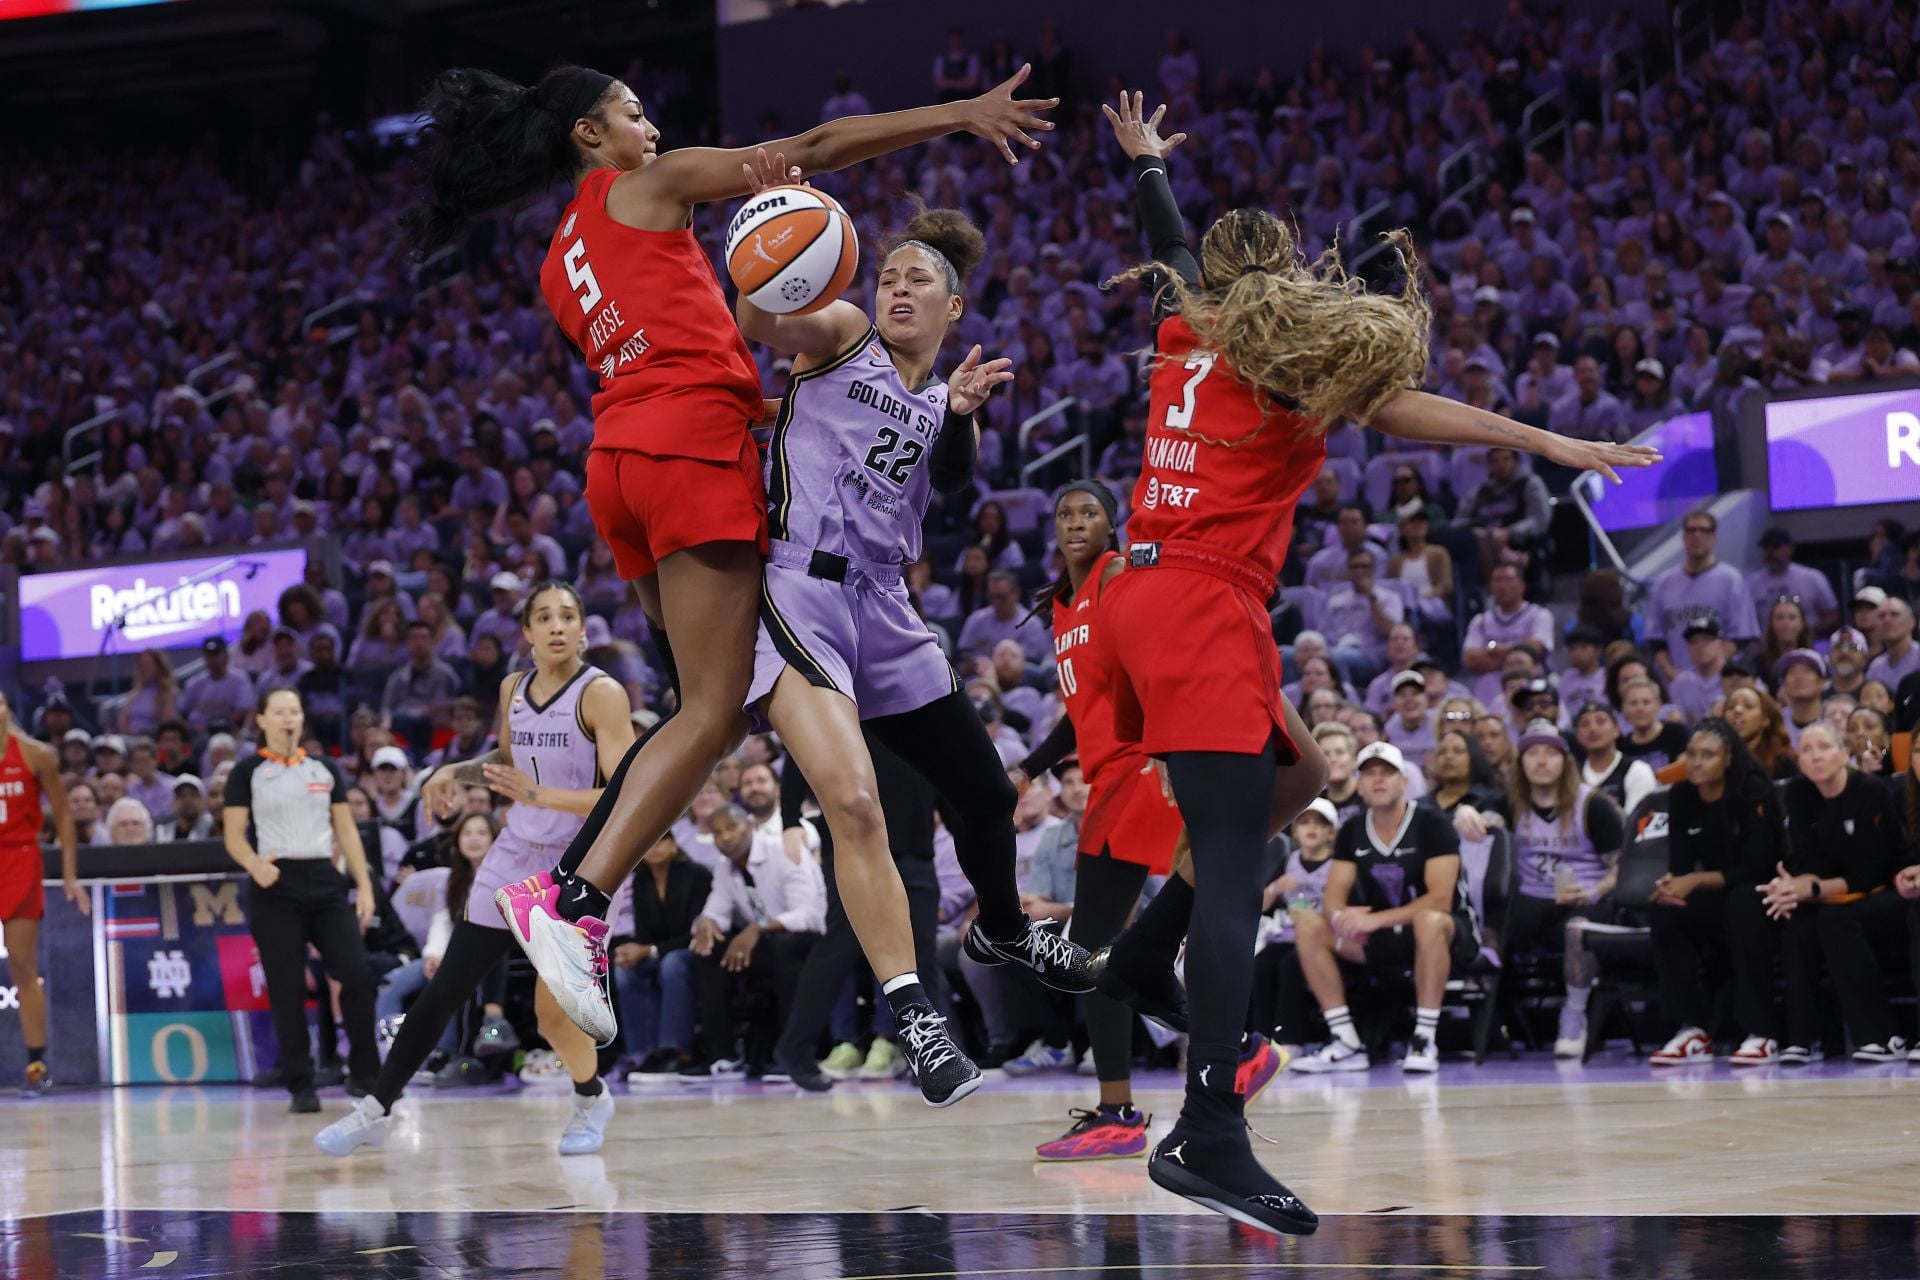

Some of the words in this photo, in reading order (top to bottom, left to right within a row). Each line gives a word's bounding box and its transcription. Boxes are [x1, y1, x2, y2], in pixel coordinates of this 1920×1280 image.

[563, 236, 603, 316] 5
[589, 300, 625, 352] REESE
[618, 328, 651, 367] AT&T
[1165, 349, 1218, 430] 3
[847, 380, 912, 425] GOLDEN
[915, 414, 941, 444] STA
[863, 424, 926, 487] 22
[1147, 436, 1198, 473] CANADA
[872, 489, 897, 506] KAISER
[1161, 483, 1200, 509] T&T
[90, 576, 241, 630] Rakuten
[1057, 658, 1077, 698] 10
[537, 732, 569, 748] STATE
[530, 755, 541, 785] 1
[189, 882, 246, 926] M
[151, 1023, 208, 1085] O
